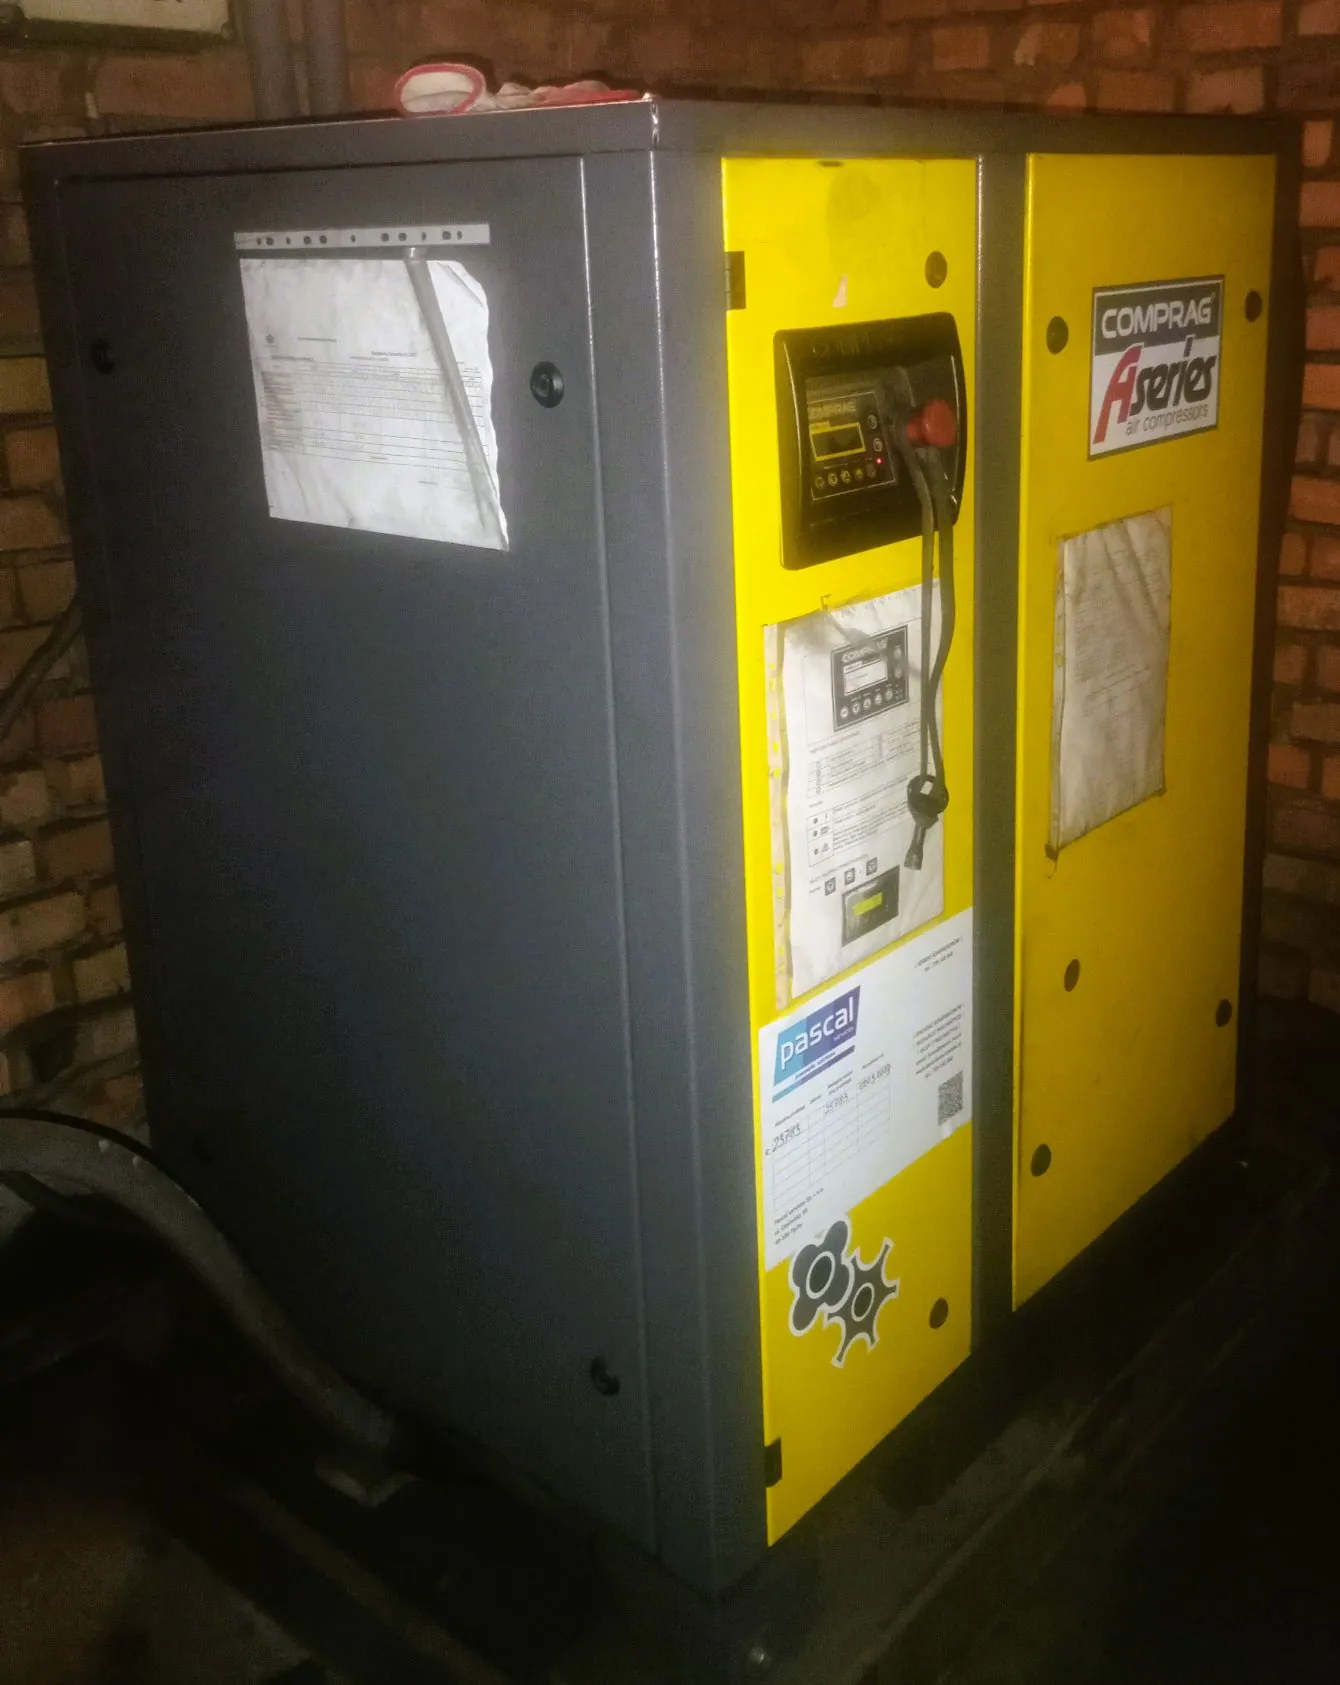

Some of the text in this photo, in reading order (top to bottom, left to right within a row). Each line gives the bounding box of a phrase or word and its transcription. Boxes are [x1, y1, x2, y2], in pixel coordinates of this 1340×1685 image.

[1101, 297, 1213, 339] COMPRAG
[1126, 403, 1208, 436] air compressors
[780, 996, 854, 1070] pascal
